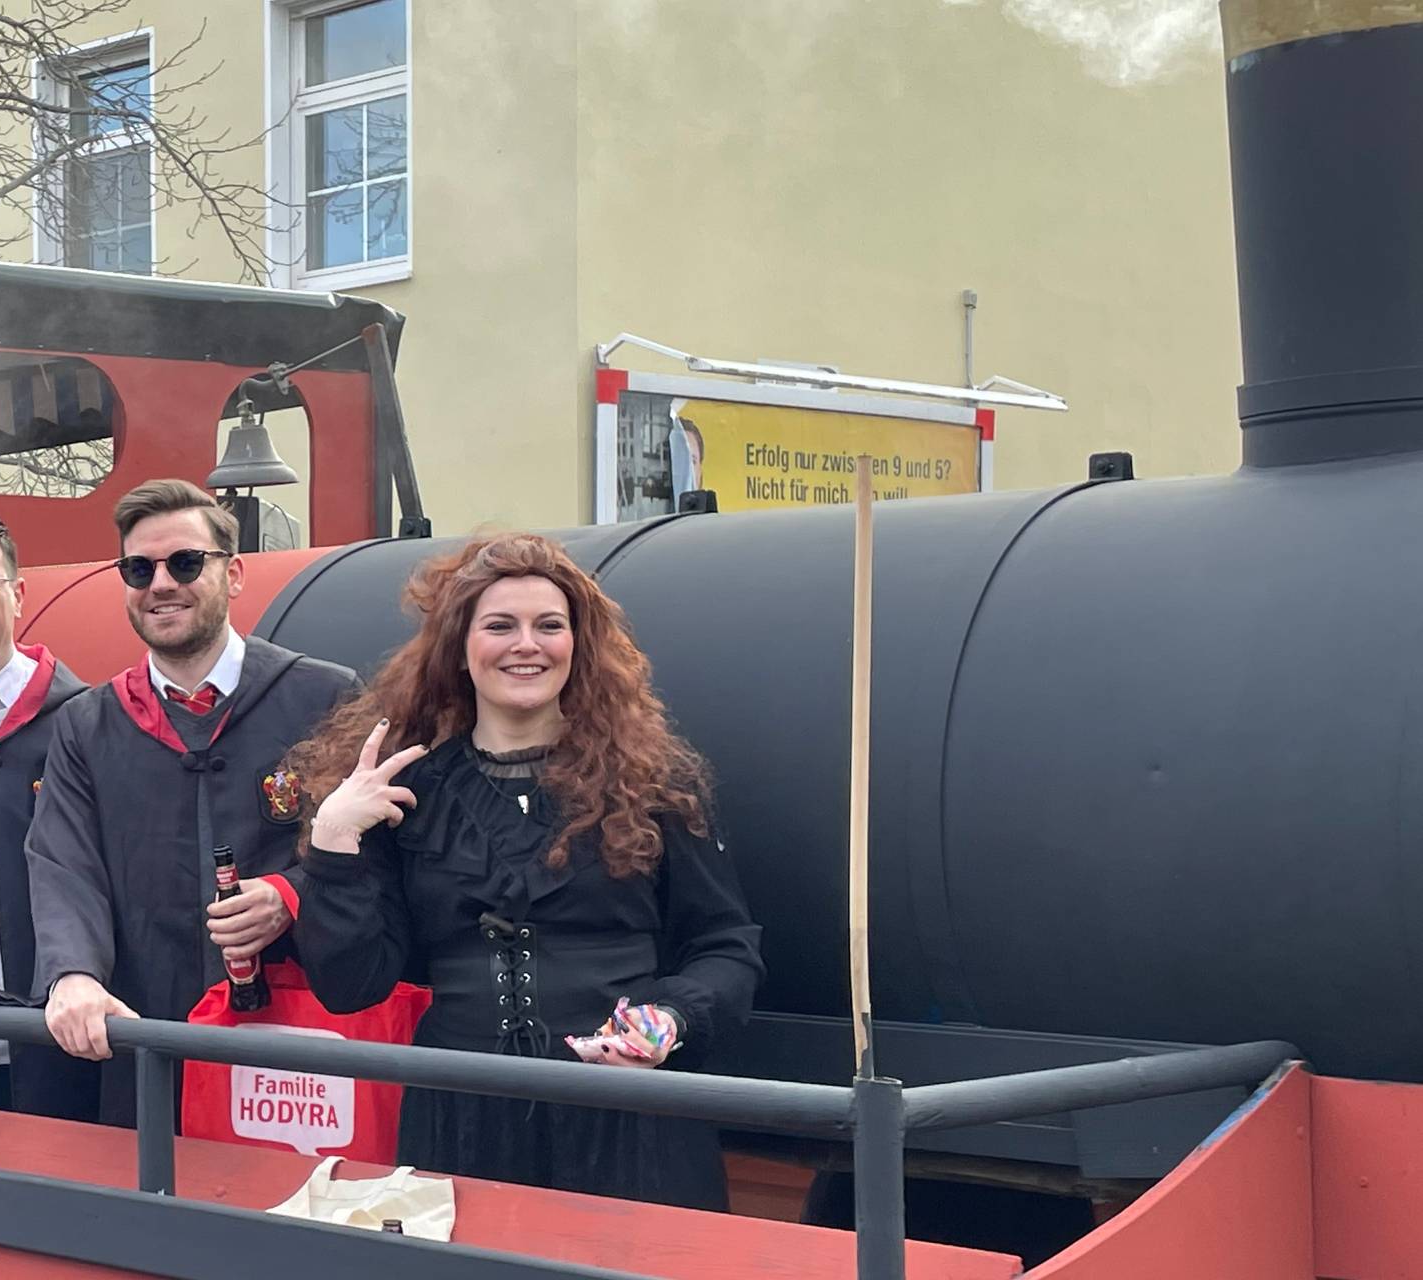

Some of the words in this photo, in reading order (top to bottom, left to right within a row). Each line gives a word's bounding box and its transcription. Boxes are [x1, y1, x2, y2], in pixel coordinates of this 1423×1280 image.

[746, 443, 789, 473] Erfolg
[794, 451, 817, 470] nur
[821, 450, 888, 476] zwisen
[893, 455, 901, 477] 9
[906, 459, 931, 479] und
[935, 459, 951, 480] 5?
[746, 476, 785, 500] Nicht
[790, 478, 808, 502] für
[255, 1074, 326, 1099] Familie
[240, 1097, 339, 1129] HODYRA
